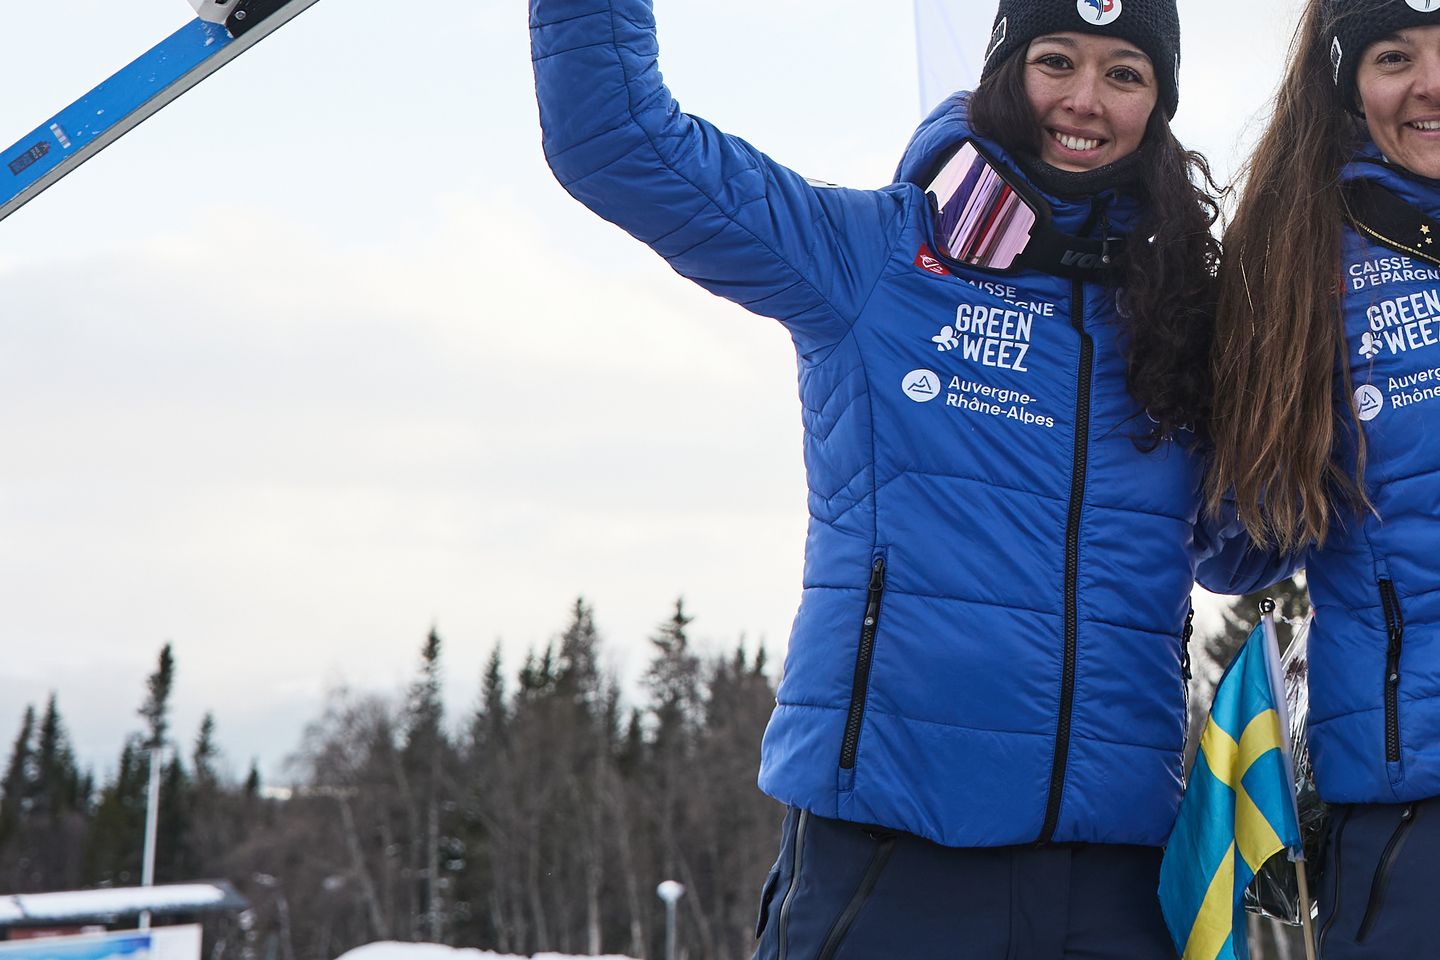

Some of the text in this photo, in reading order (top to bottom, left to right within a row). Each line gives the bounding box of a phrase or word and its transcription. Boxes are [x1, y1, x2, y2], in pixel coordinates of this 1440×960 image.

[1349, 256, 1413, 277] CAISSE
[955, 303, 1034, 342] GREEN
[963, 334, 1031, 373] WEEZ
[948, 375, 1037, 405] Auvergne-
